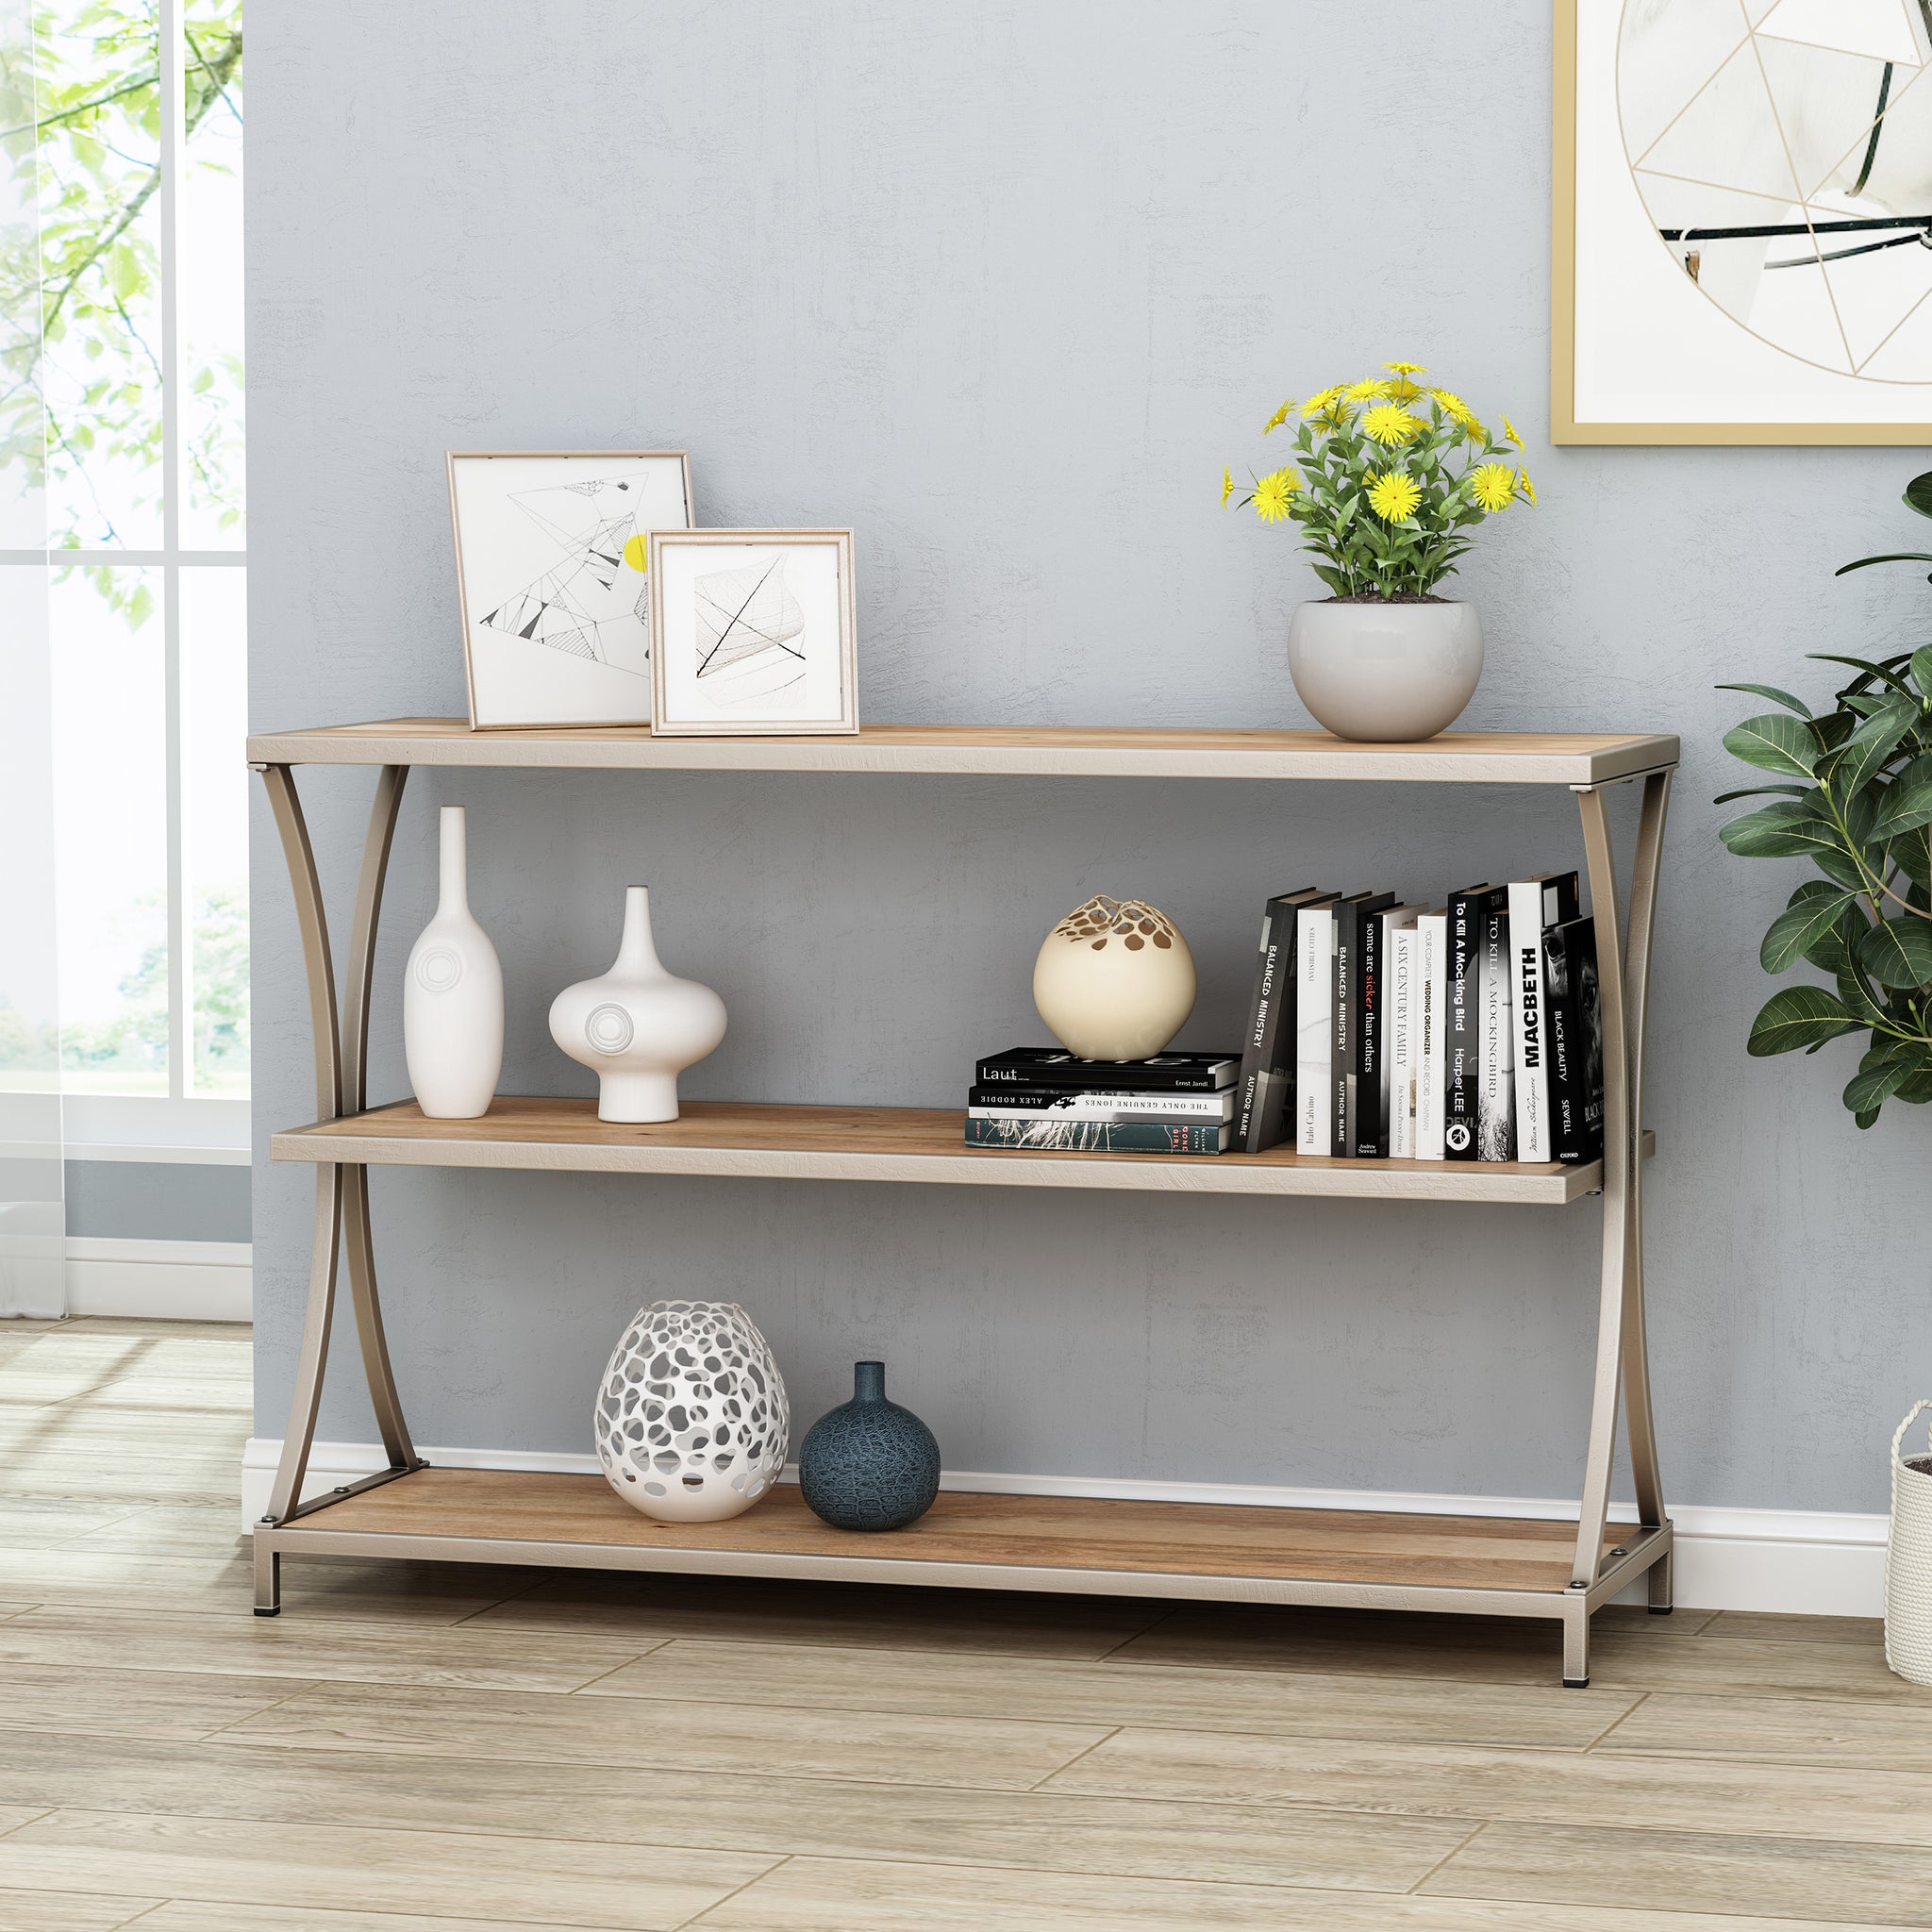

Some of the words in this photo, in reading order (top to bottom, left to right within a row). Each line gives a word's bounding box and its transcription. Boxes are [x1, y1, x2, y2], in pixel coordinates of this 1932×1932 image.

[1457, 902, 1466, 915] To
[1457, 919, 1466, 936] Kill
[1490, 918, 1498, 939] TO
[1399, 946, 1408, 963] SIX
[1457, 940, 1466, 950] A
[1489, 942, 1498, 974] KILL
[1261, 945, 1277, 996] BALANCED
[1339, 946, 1347, 997] BALANCED
[1454, 952, 1466, 1005] Mocking
[1489, 977, 1497, 987] A
[1366, 974, 1375, 1009] sicker
[1398, 967, 1407, 1022] CENTURY
[1456, 1008, 1465, 1031] Bird
[1522, 947, 1539, 1068] MACBETH
[1253, 1000, 1269, 1048] MINISTRY
[1338, 1003, 1346, 1052] MINISTRY
[1366, 1012, 1374, 1036] than
[1555, 1010, 1564, 1041] BLACK
[1365, 1038, 1374, 1073] others
[1397, 1024, 1407, 1067] FAMILY
[1489, 992, 1498, 1098] MOCKINGBIRD
[983, 1067, 1018, 1081] Laut
[1454, 1048, 1465, 1090] Harper
[1557, 1042, 1568, 1082] BEAUTY
[1085, 1099, 1113, 1108] JONES
[1243, 1075, 1256, 1109] AUTHOR
[1455, 1092, 1464, 1111] LEE
[1239, 1112, 1249, 1137] NAME
[1306, 1096, 1314, 1125] Calvino
[1561, 1099, 1572, 1135] SEWELL
[1306, 1127, 1314, 1144] Italo
[1527, 1126, 1538, 1153] William
